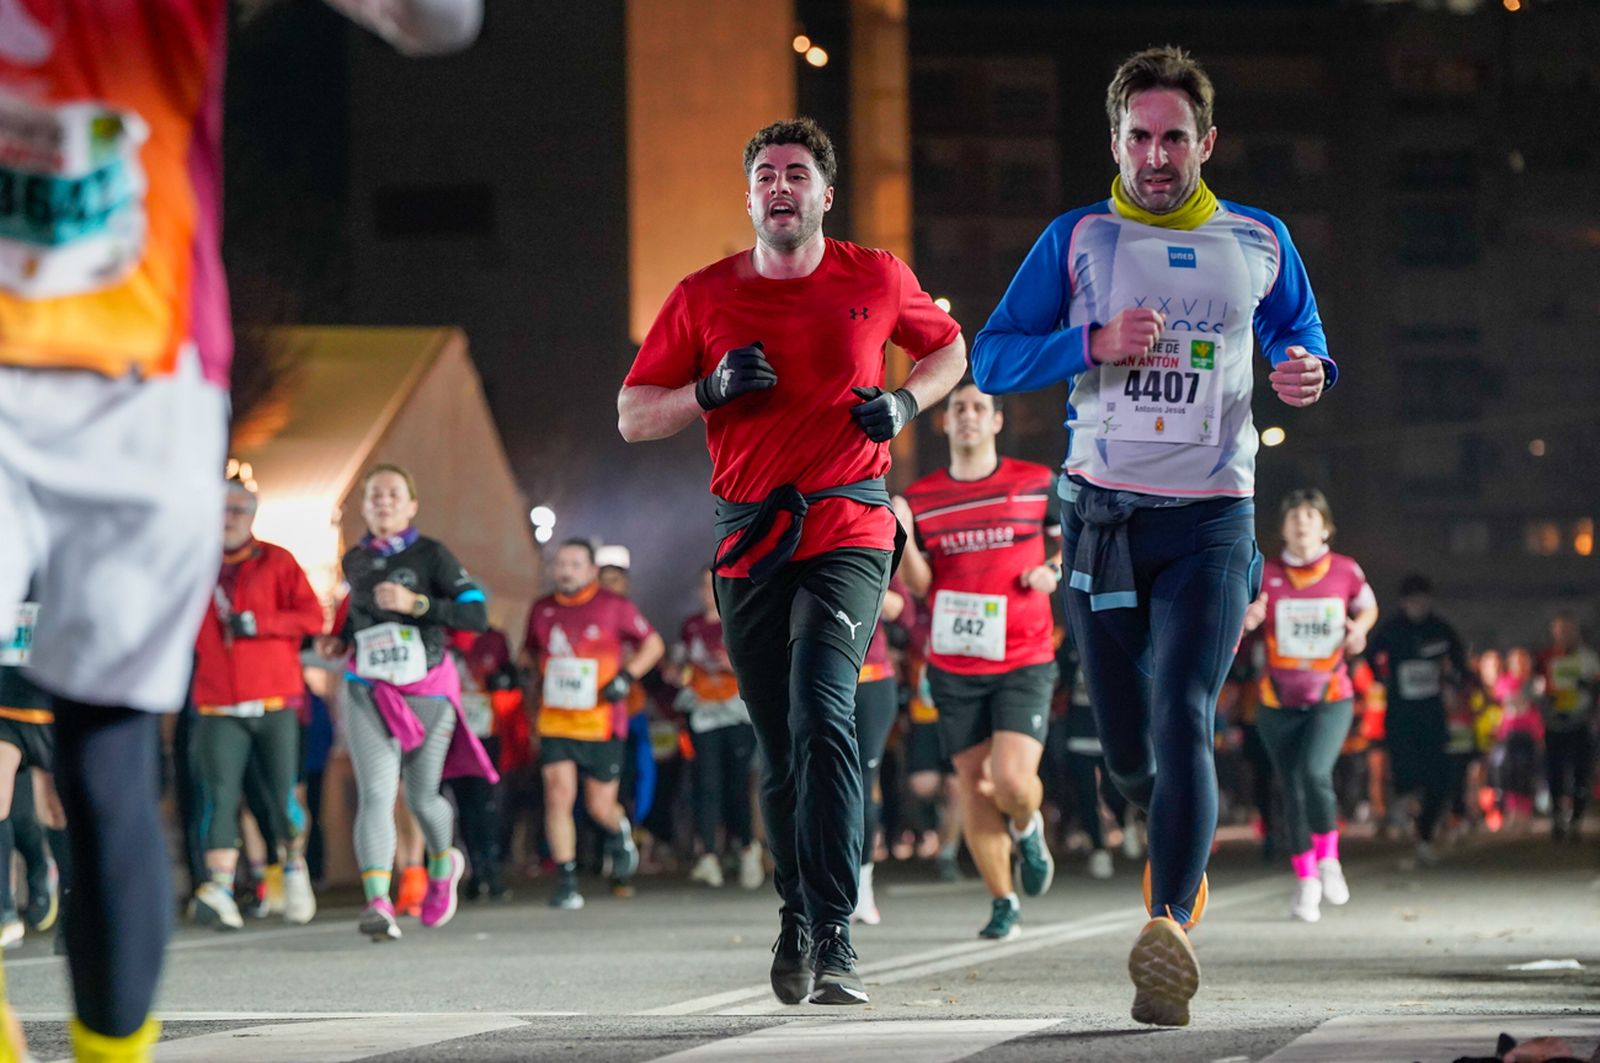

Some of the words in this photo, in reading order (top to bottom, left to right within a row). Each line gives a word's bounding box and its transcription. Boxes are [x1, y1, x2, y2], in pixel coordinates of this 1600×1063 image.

[1134, 295, 1228, 320] XXVII
[1165, 343, 1180, 354] DE
[1124, 369, 1201, 405] 4407
[1135, 405, 1163, 414] Antonio
[952, 617, 985, 637] 642
